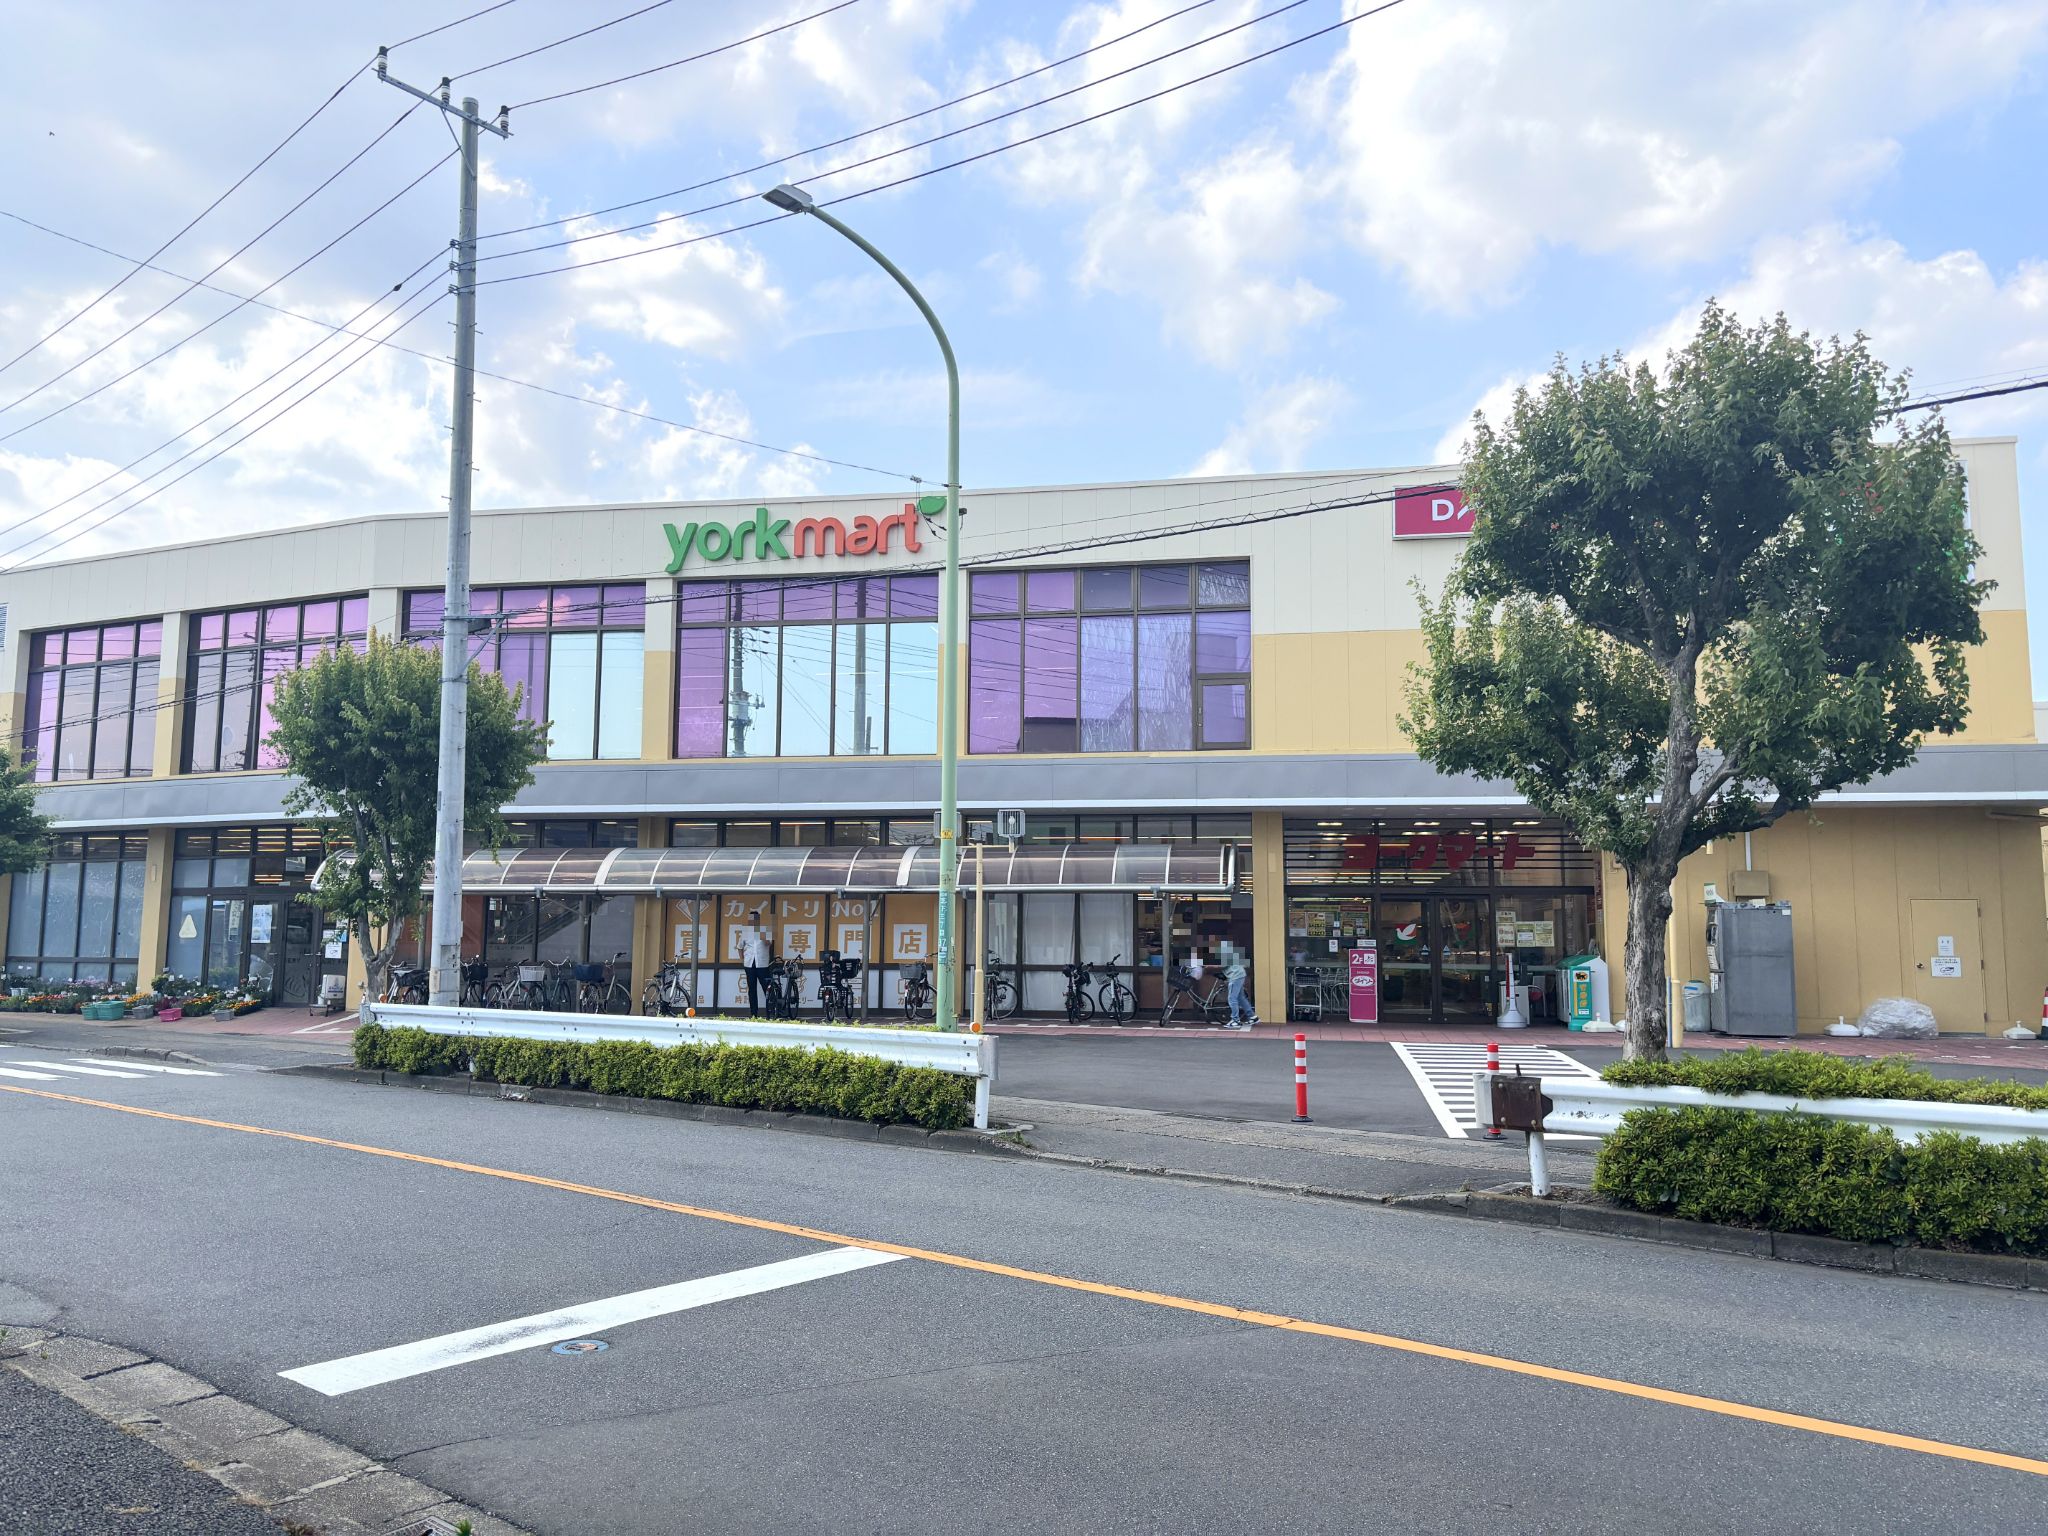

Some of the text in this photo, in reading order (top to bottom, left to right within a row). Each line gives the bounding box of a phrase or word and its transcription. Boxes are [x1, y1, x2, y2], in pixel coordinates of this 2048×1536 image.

[1341, 833, 1536, 870] ヨークマート
[724, 898, 820, 918] カイトリ
[679, 929, 922, 955] 買専門店
